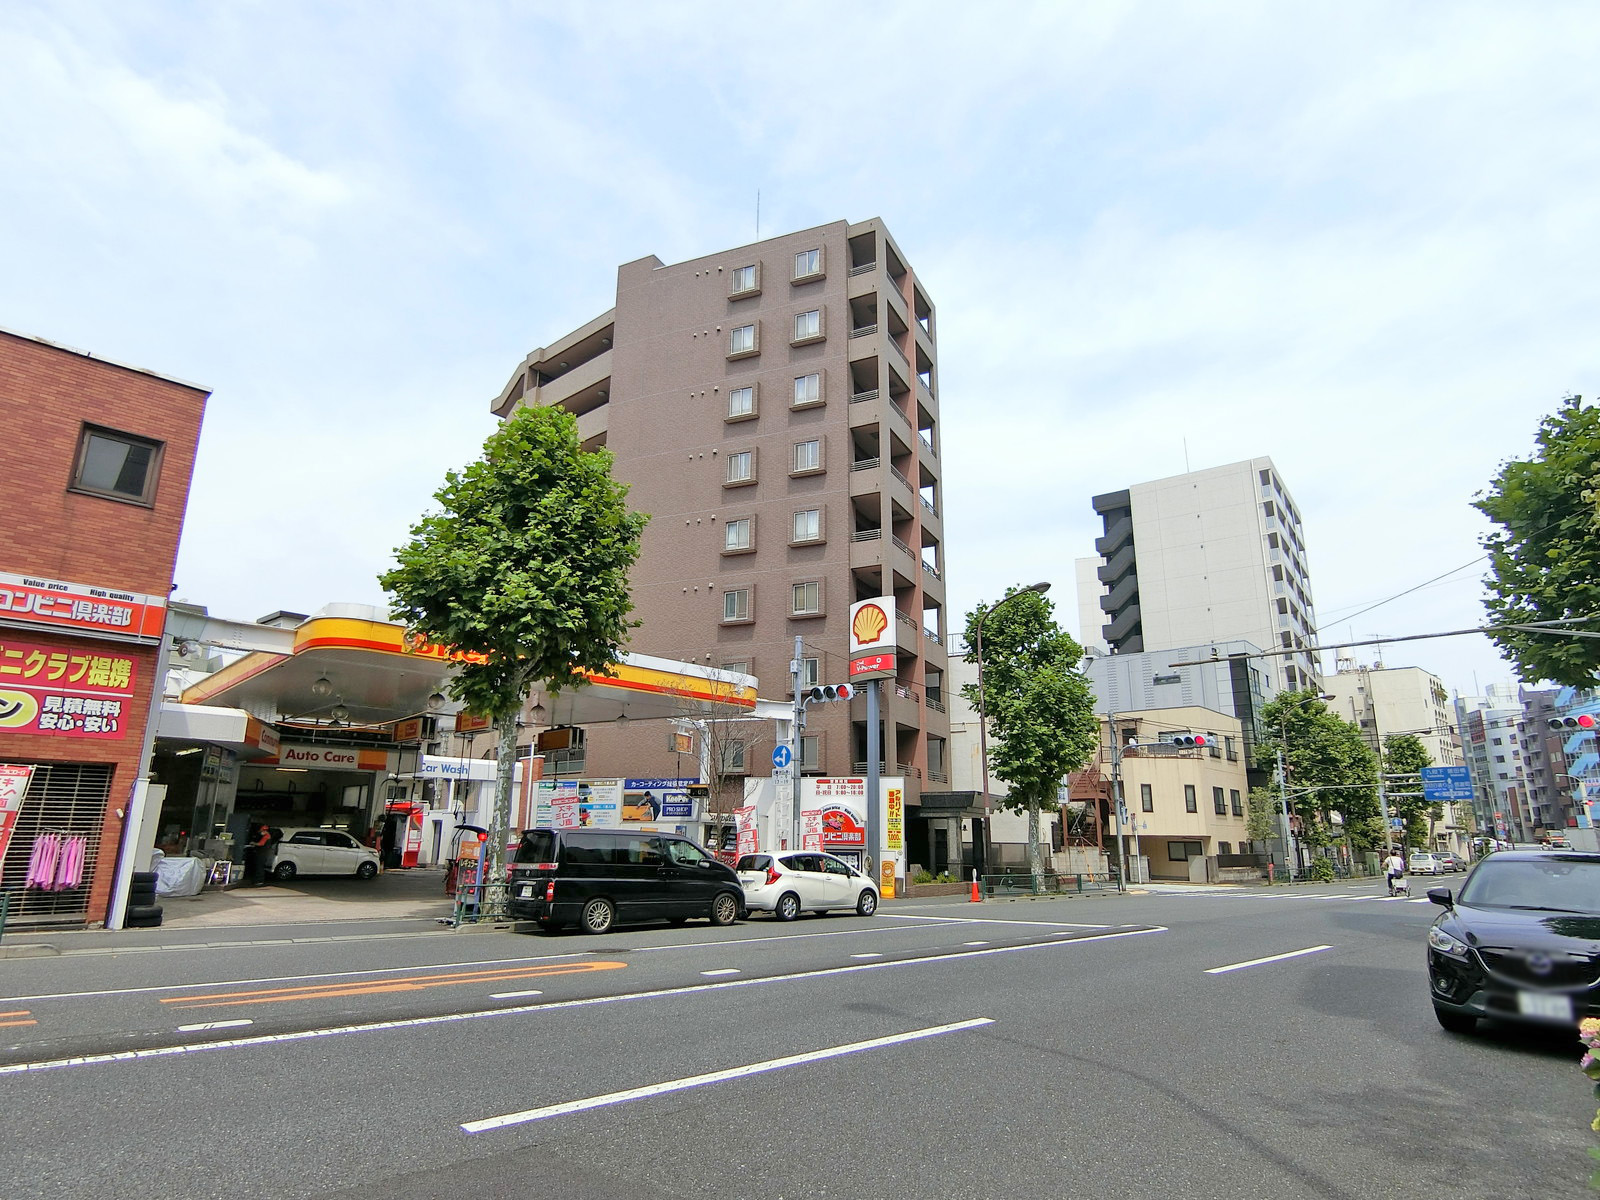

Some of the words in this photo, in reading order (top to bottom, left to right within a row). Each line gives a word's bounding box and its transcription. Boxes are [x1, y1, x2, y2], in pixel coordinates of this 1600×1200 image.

[23, 578, 46, 589] Value
[48, 583, 69, 592] price
[89, 588, 107, 599] High
[109, 592, 135, 602] quality
[0, 645, 133, 688] ニクラブ提携
[42, 695, 121, 718] 見積無料
[285, 748, 320, 761] Auto
[324, 751, 355, 763] Care
[421, 762, 438, 772] Car
[441, 763, 468, 775] Wash
